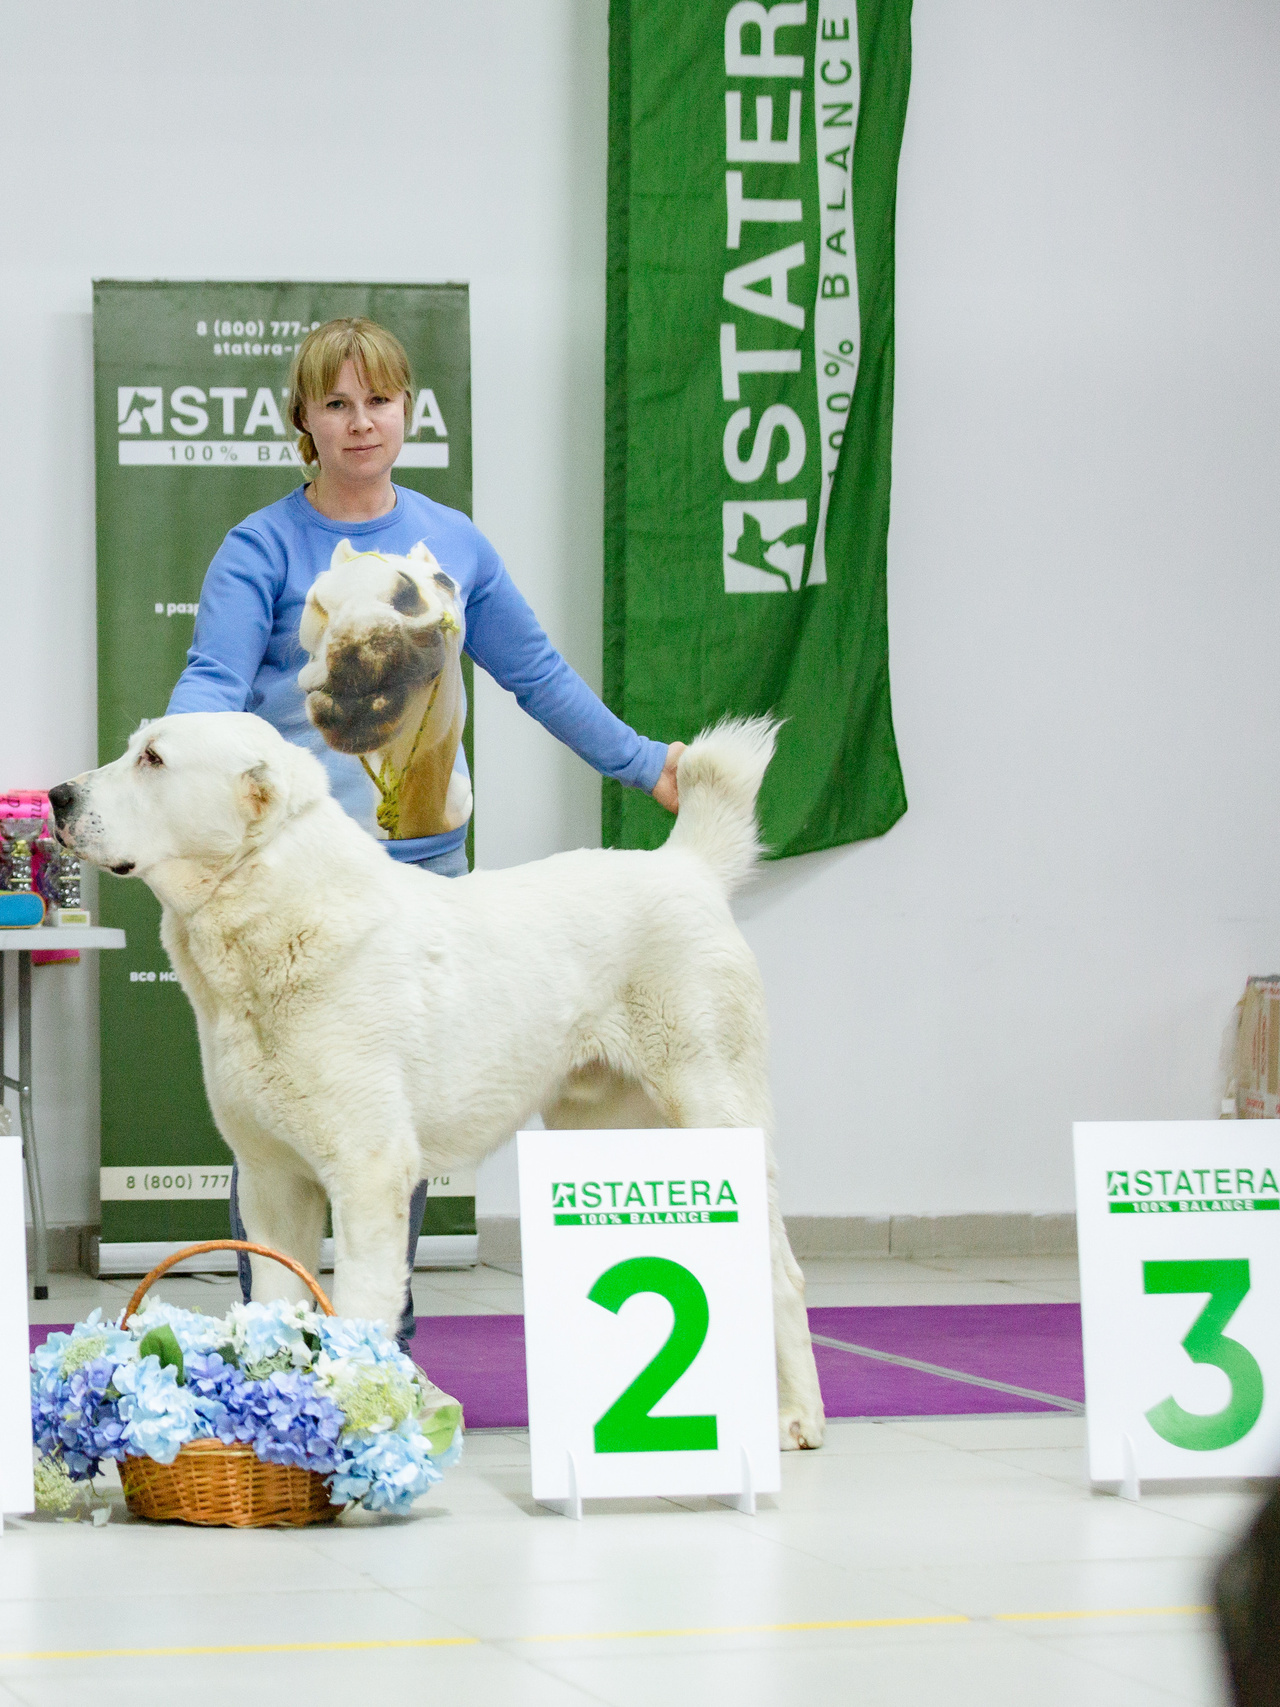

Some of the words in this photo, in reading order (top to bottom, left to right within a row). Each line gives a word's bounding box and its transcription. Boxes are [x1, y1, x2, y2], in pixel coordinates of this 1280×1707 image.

[821, 18, 852, 299] BALANCE
[197, 321, 207, 336] 8
[214, 319, 264, 338] (800)
[170, 386, 448, 436] STAA
[168, 445, 238, 462] 100%
[130, 971, 156, 982] все
[126, 1175, 136, 1189] 8
[144, 1173, 192, 1190] (800)
[1134, 1168, 1280, 1196] STATERA
[581, 1179, 738, 1208] STATERA
[1133, 1201, 1173, 1213] 100%
[1179, 1199, 1255, 1212] BALANCE
[580, 1213, 622, 1225] 100%
[630, 1211, 710, 1224] BALANCE
[586, 1256, 718, 1454] 2
[1141, 1259, 1264, 1452] 3
